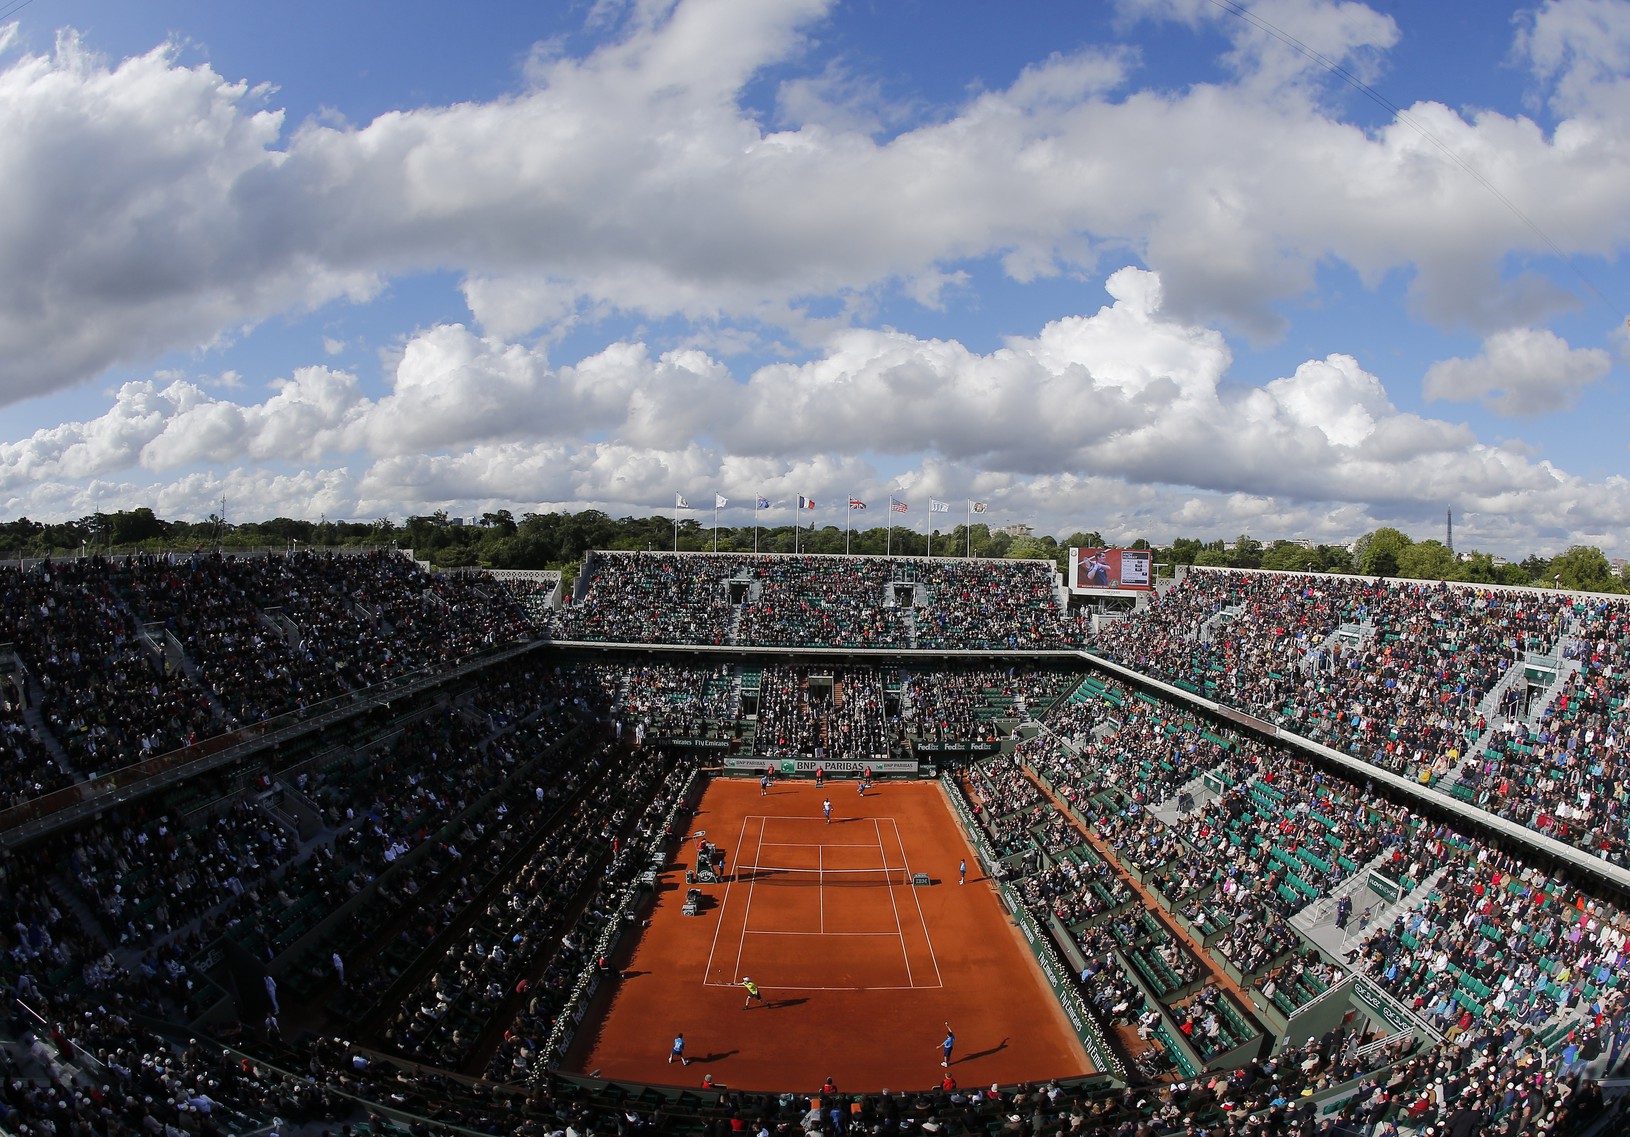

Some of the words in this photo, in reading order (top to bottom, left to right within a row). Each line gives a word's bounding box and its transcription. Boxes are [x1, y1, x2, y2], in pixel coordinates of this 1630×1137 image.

[797, 762, 816, 770] BNP
[825, 762, 864, 771] PARIBAS
[1042, 960, 1059, 988] Emirates
[1065, 999, 1084, 1032] Emirates
